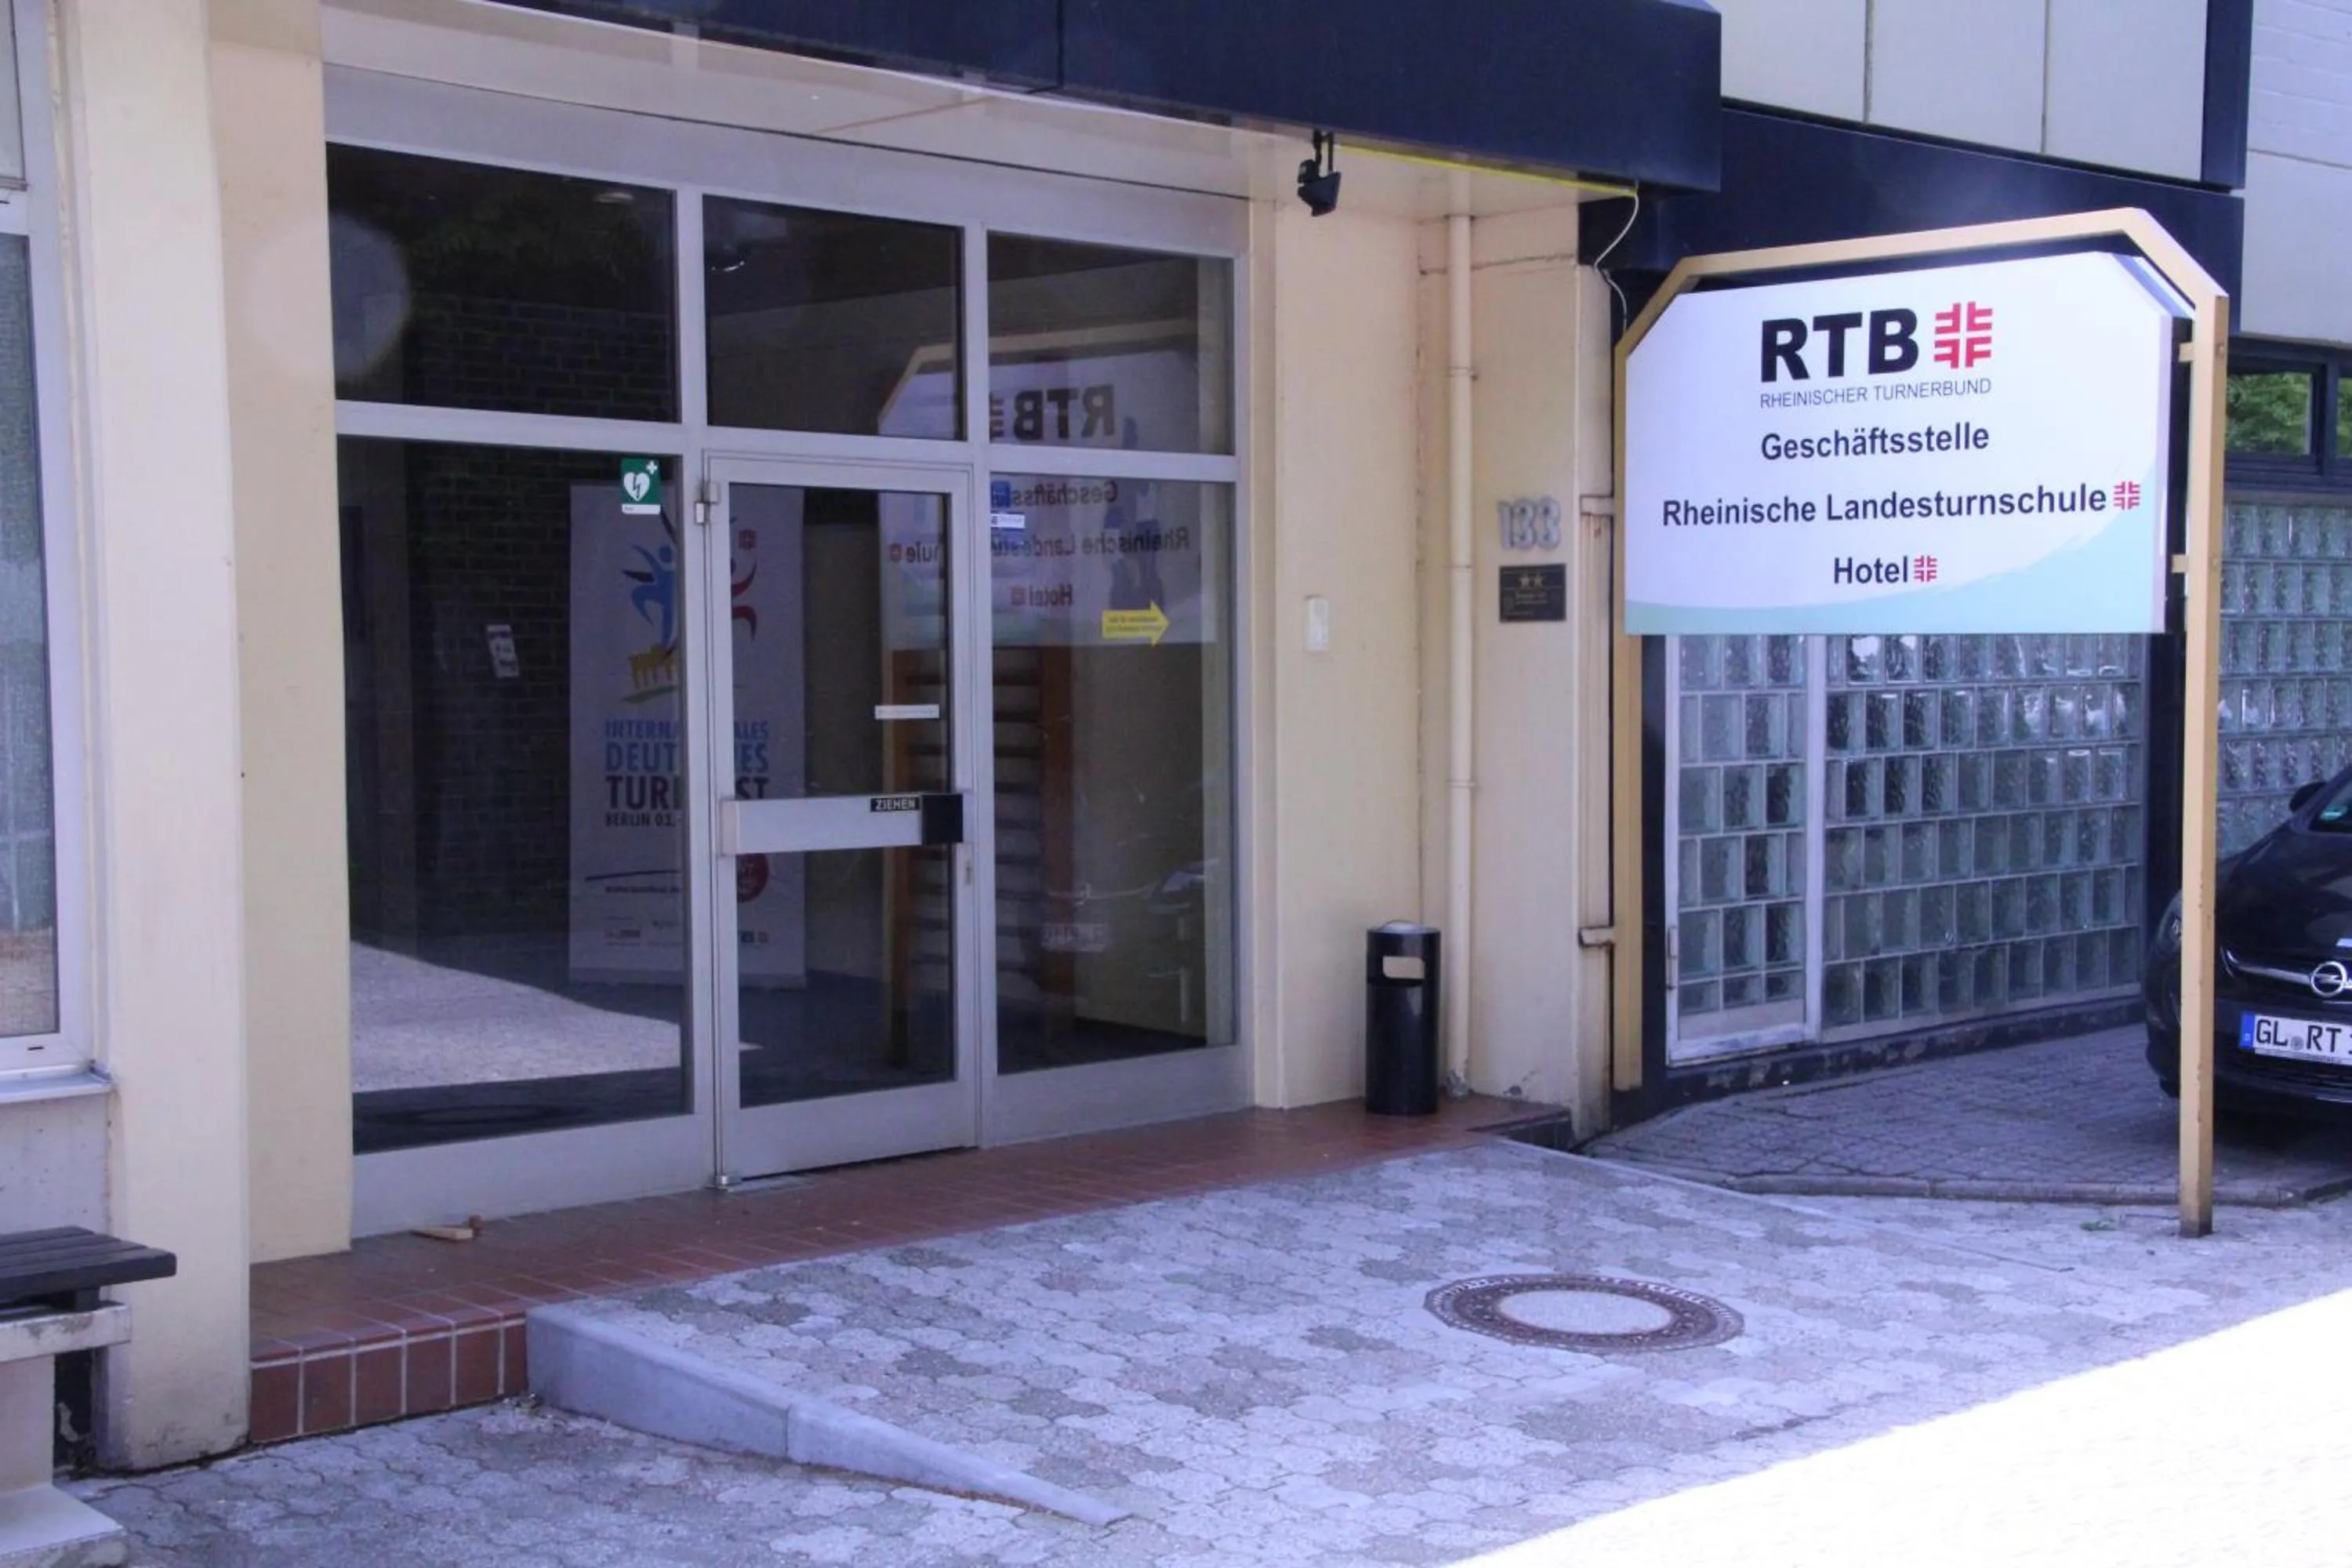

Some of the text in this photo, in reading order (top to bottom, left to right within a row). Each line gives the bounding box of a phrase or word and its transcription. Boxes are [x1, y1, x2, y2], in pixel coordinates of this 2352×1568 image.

[1760, 308, 1919, 383] RTB
[1760, 378, 1992, 409] RHEINISCHER TURNERBUND
[1761, 422, 1990, 461] Geschäftsstelle
[1663, 483, 2107, 528] Rheinische Landesturnschule
[1833, 555, 1909, 585] Hotel
[875, 798, 916, 811] ZIEHEN
[2256, 1018, 2288, 1047] GL
[2306, 1025, 2343, 1053] RT
